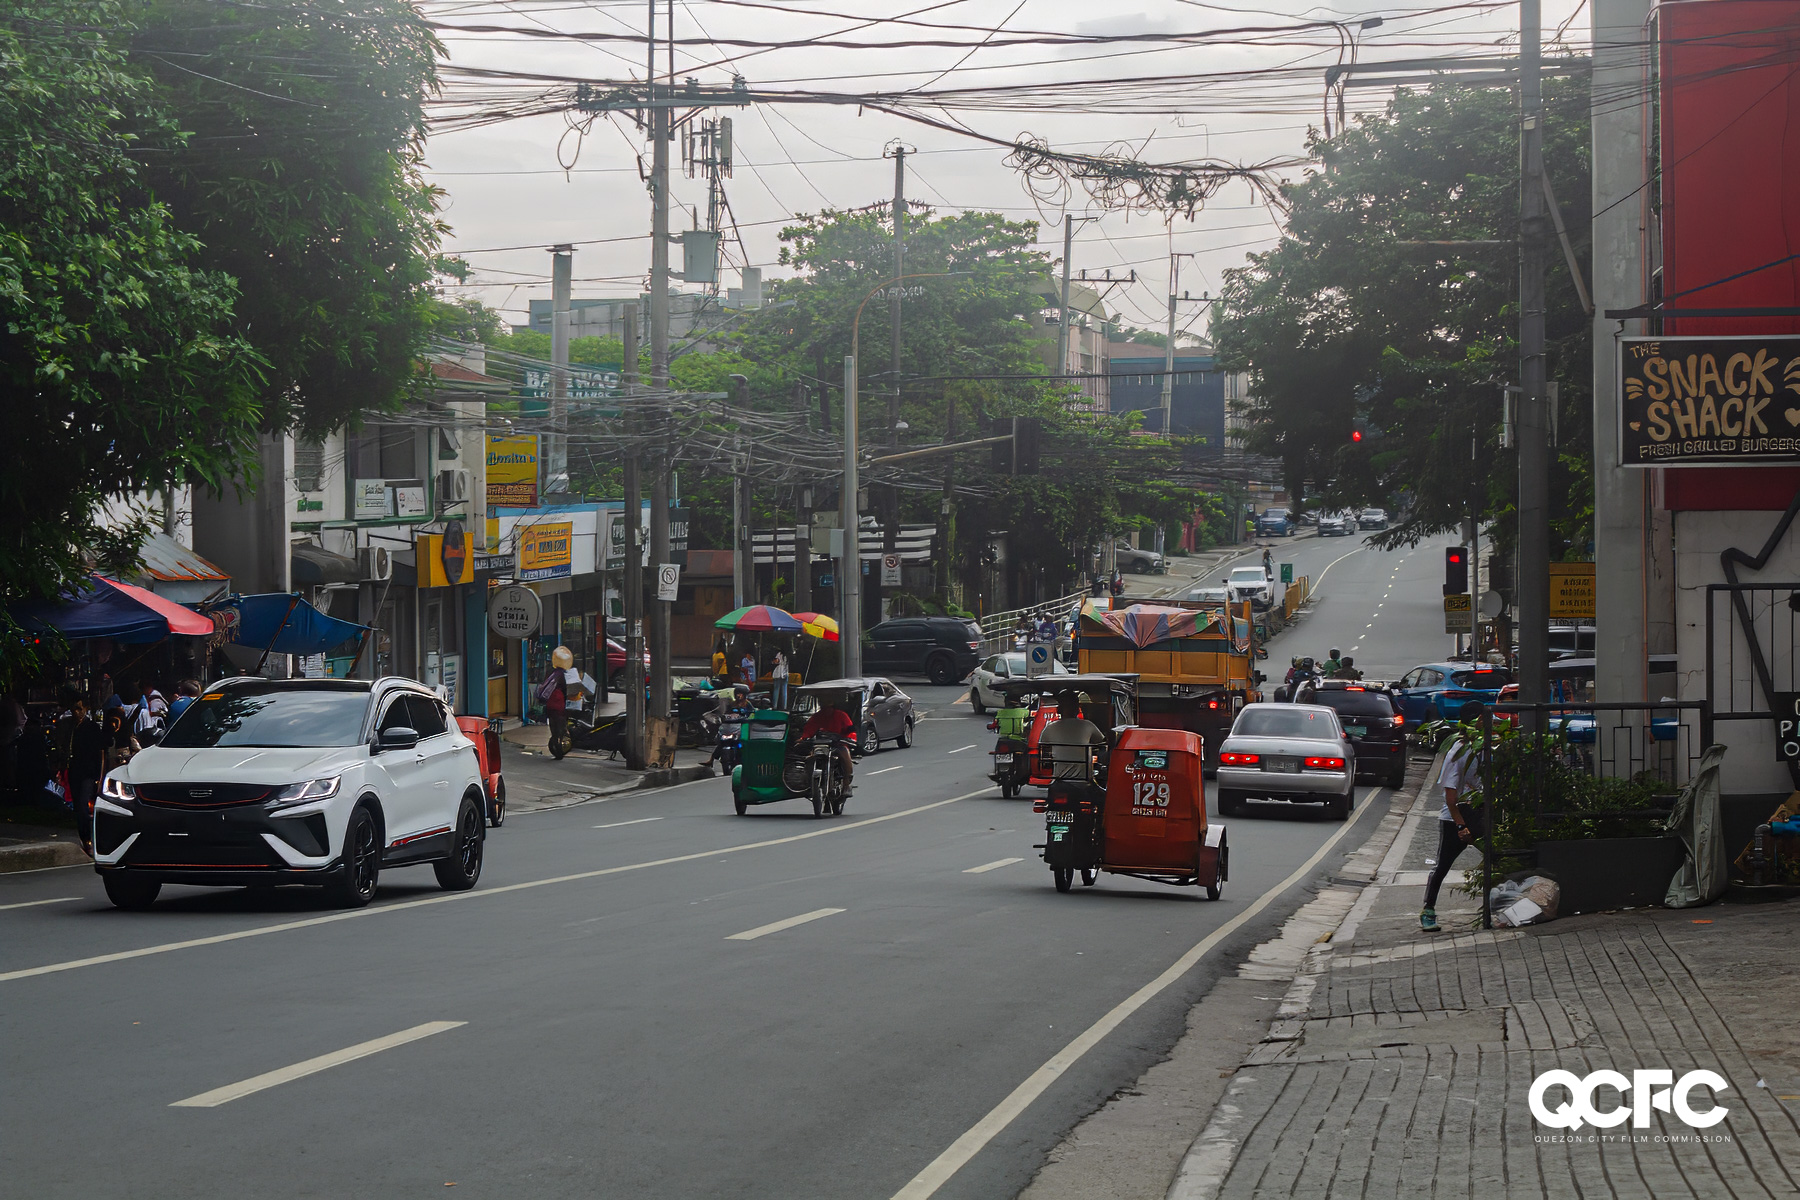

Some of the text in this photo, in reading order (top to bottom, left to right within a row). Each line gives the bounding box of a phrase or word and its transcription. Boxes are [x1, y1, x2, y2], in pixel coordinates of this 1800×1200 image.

[1629, 342, 1661, 358] THE
[1643, 348, 1779, 401] SNACK
[1647, 394, 1771, 441] SHACK
[1639, 443, 1681, 458] FRESH
[1683, 439, 1737, 454] GRILLED
[1133, 782, 1170, 807] 129
